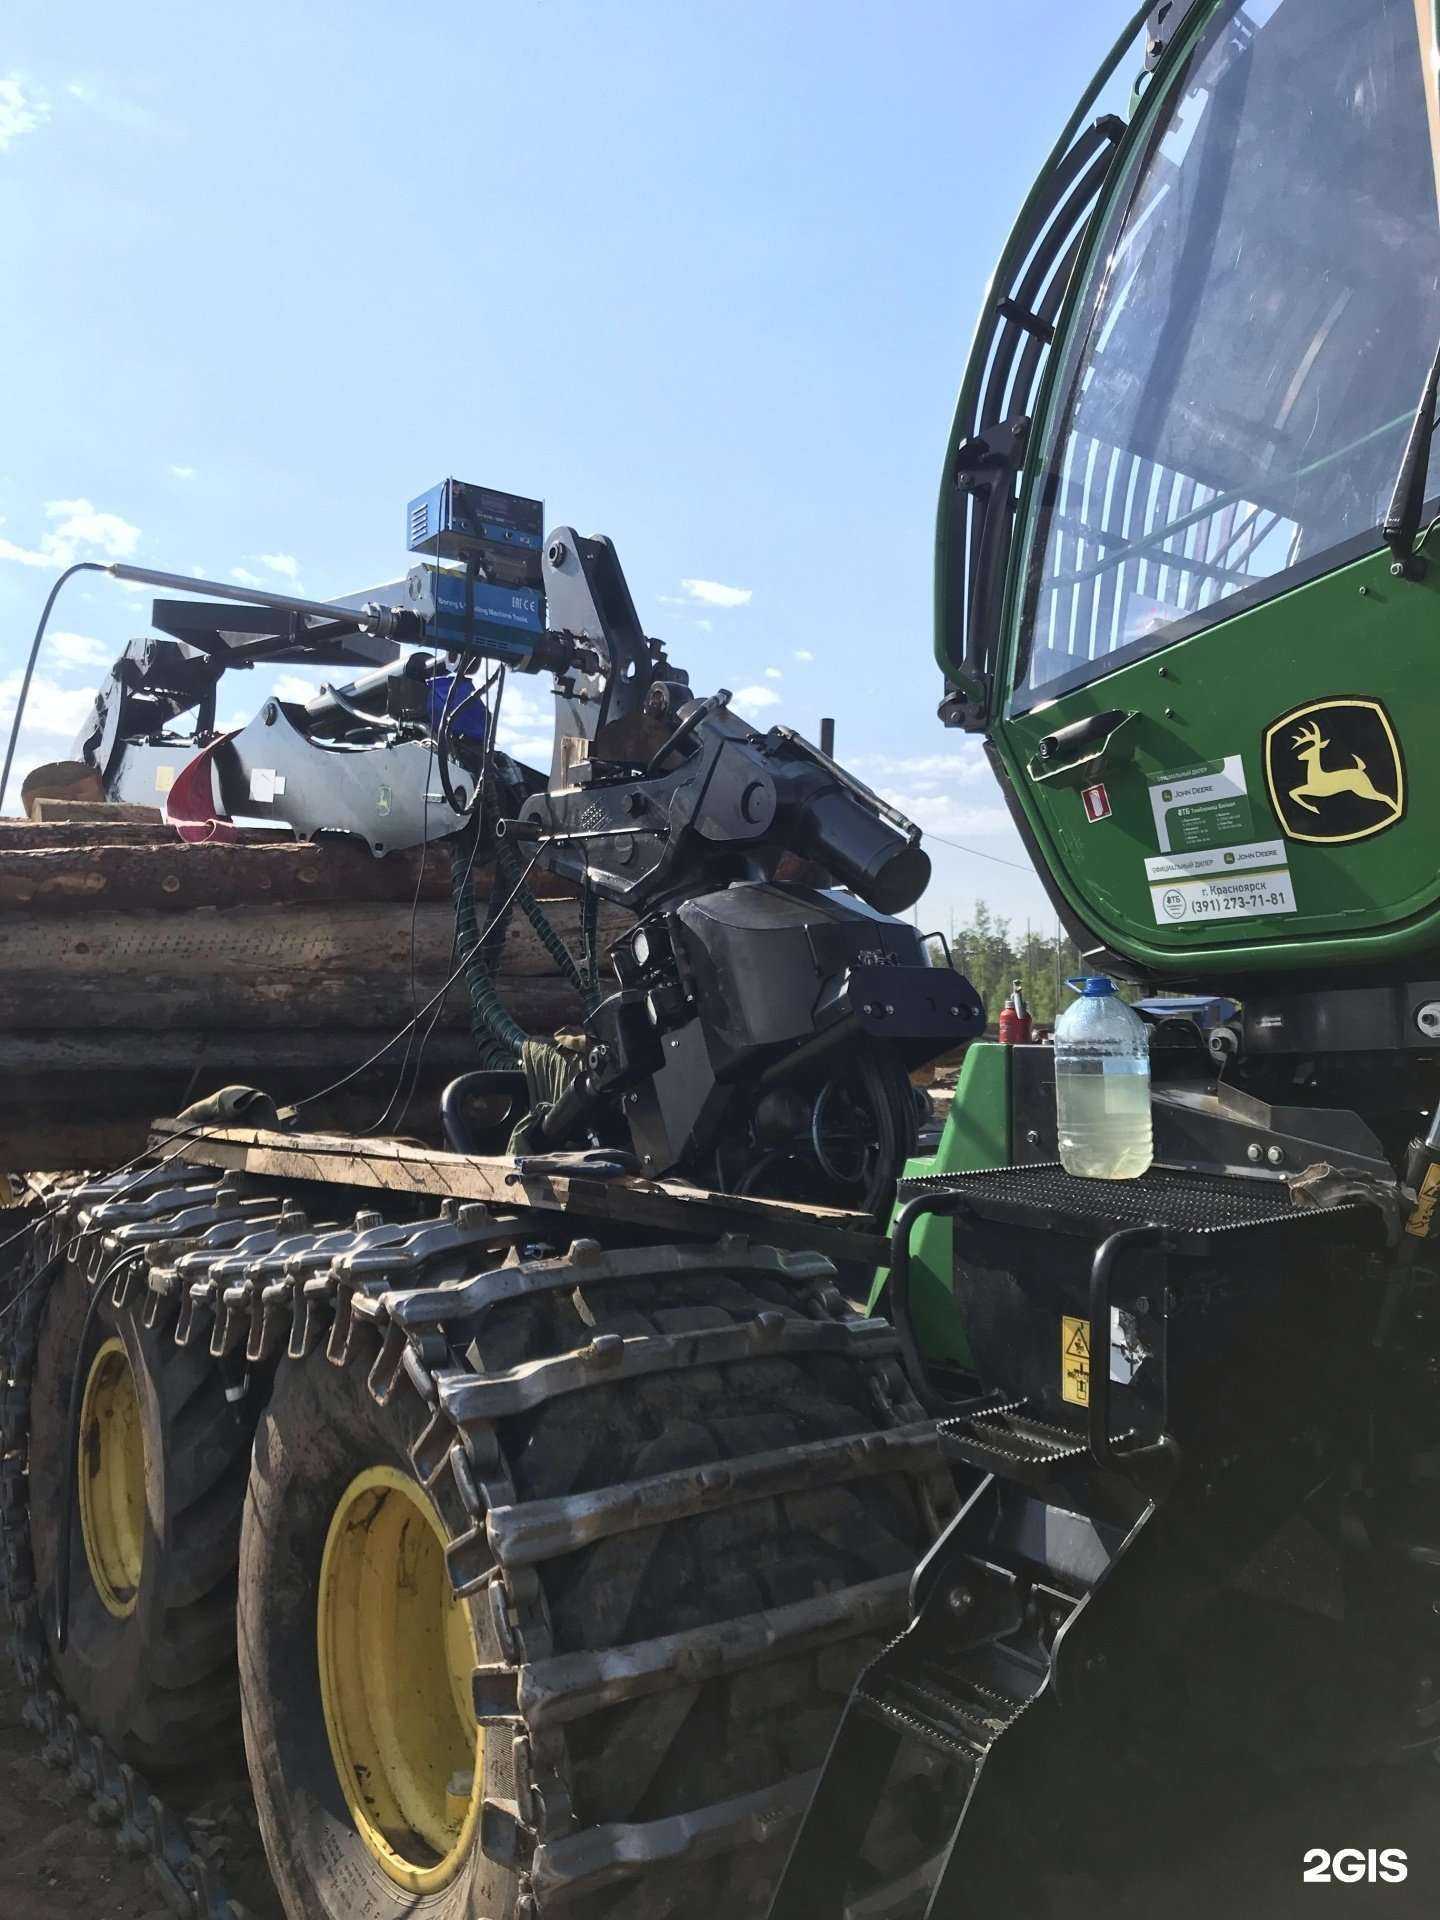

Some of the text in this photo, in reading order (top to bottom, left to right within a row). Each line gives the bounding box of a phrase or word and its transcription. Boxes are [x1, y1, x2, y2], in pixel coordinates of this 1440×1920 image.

[1175, 785, 1214, 799] JOHN DEERE
[1237, 849, 1279, 861] JOHN DEERE
[1210, 881, 1268, 897] Красноярск
[1191, 899, 1221, 915] (391)
[1224, 892, 1286, 911] 273-71-81
